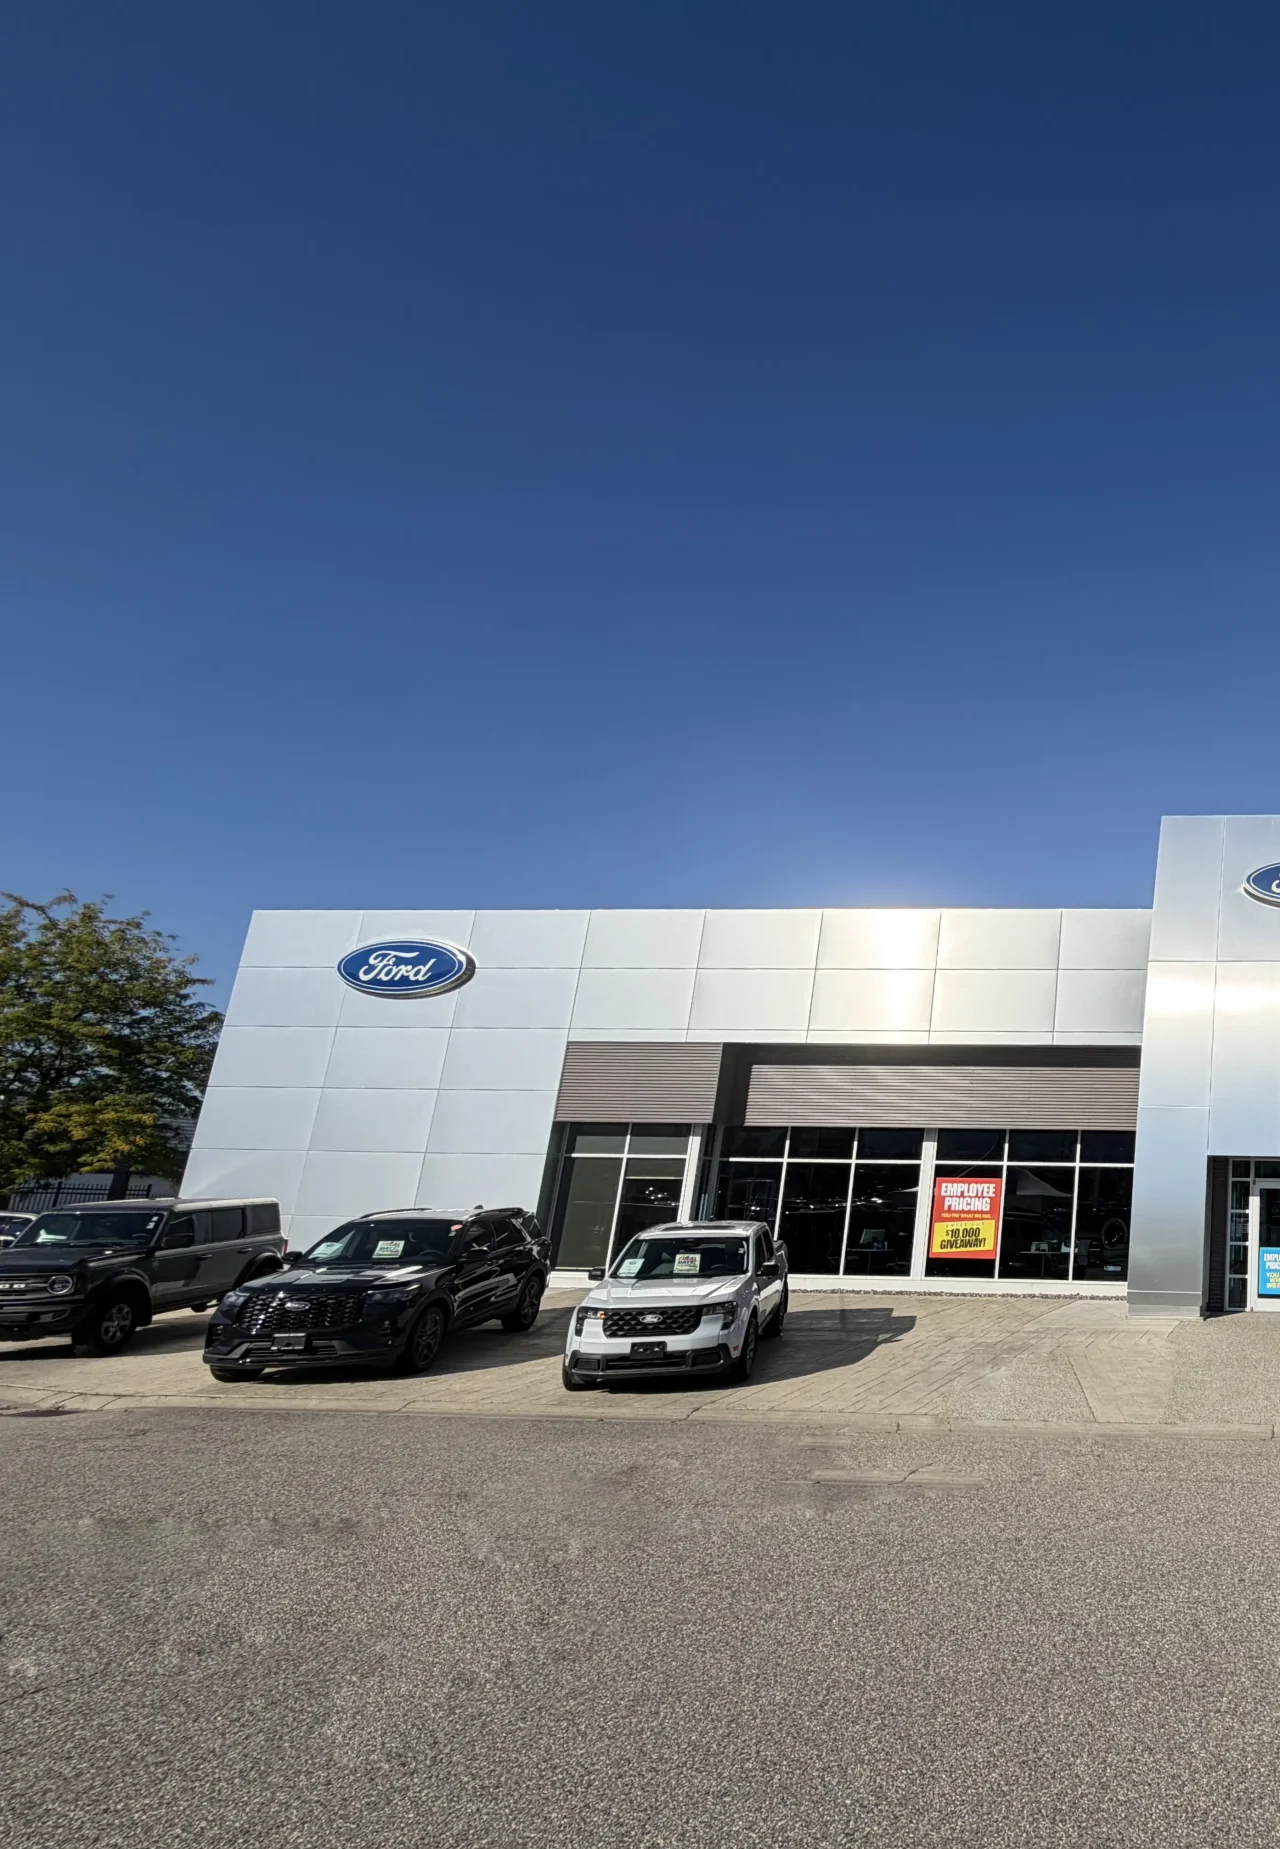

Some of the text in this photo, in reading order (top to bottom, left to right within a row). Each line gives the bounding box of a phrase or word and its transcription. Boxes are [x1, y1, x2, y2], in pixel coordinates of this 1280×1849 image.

[358, 950, 437, 981] Ford
[941, 1182, 996, 1197] EMPLOYEE
[944, 1197, 990, 1211] PRICING
[940, 1237, 987, 1250] GIVEAWAY!
